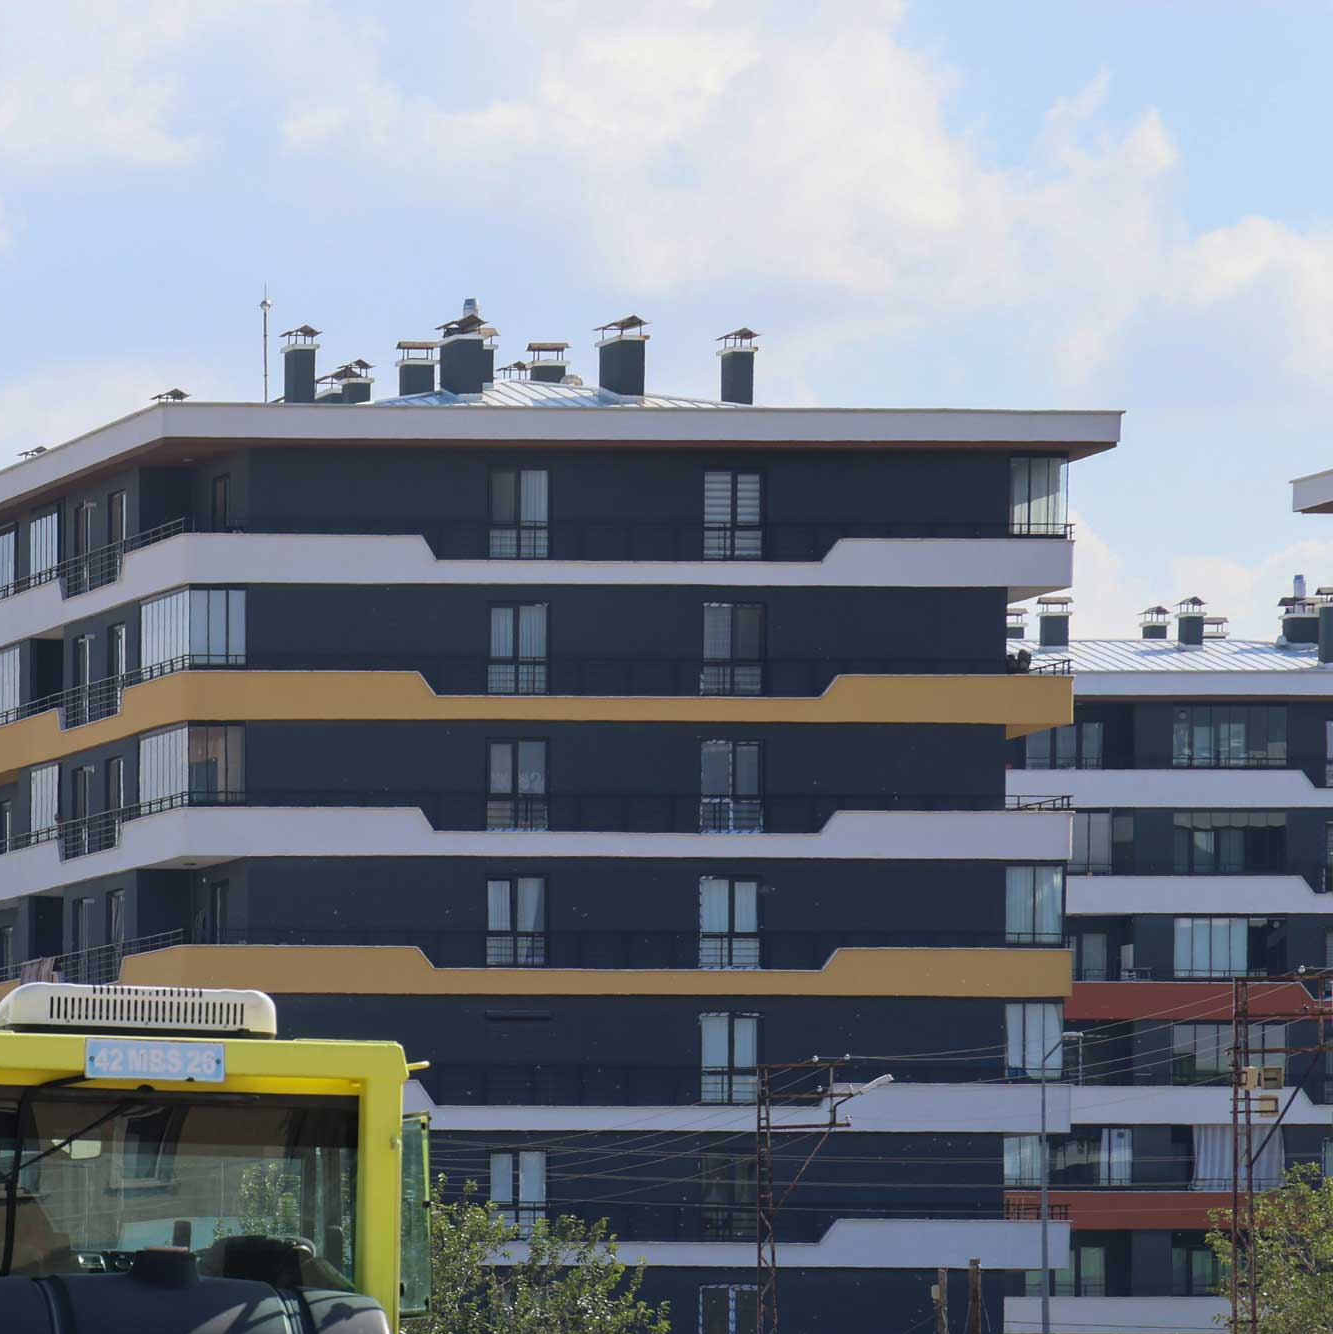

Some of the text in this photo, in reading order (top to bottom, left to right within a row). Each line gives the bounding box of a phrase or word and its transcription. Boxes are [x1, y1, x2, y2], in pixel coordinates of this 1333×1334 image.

[94, 1047, 218, 1075] 42 MBS 26
